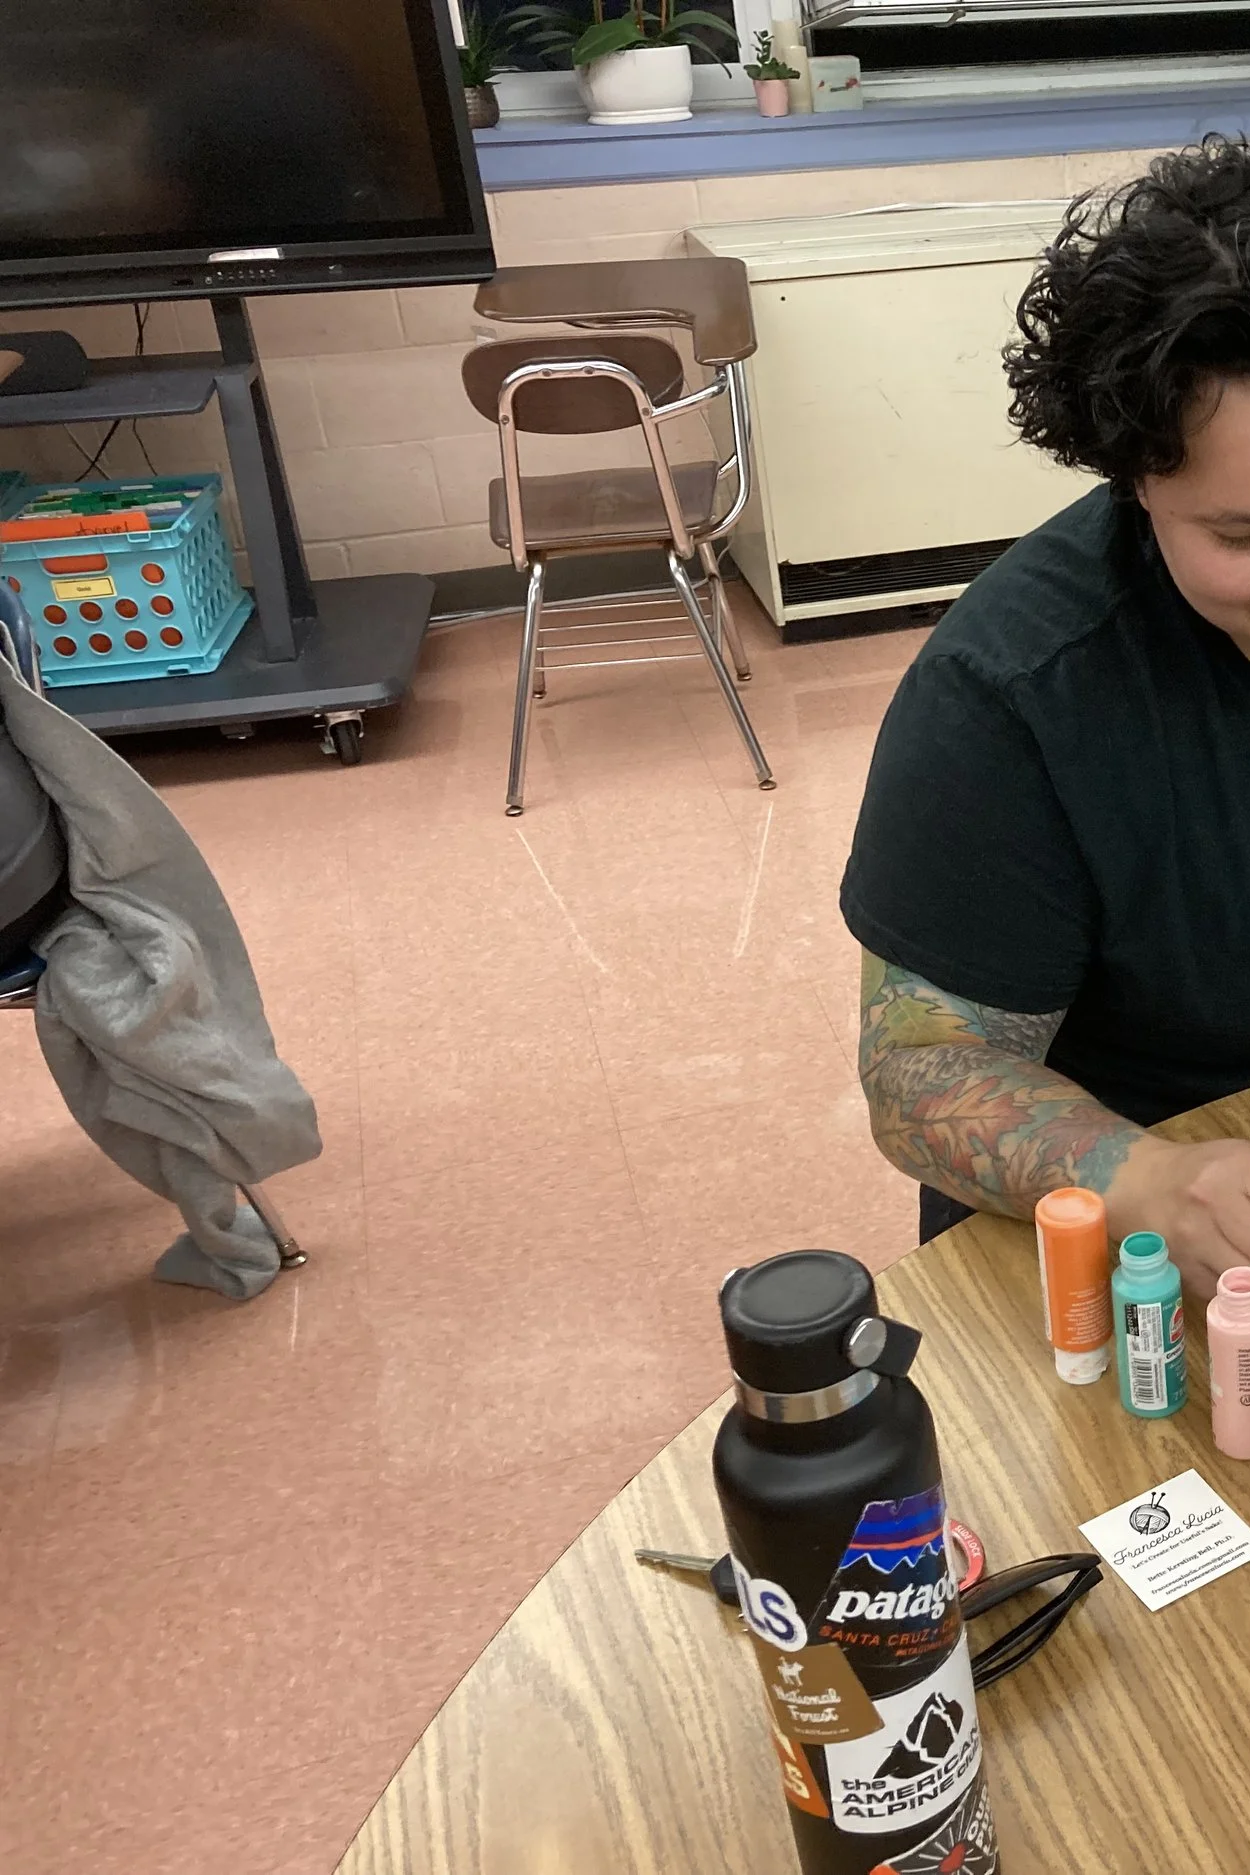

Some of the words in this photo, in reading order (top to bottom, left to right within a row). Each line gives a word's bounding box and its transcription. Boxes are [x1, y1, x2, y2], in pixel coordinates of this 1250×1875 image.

[1113, 1527, 1184, 1565] Francesca
[1183, 1504, 1224, 1530] Lucia
[1169, 1541, 1180, 1552] for
[819, 1625, 881, 1647] SANTA
[887, 1627, 930, 1647] CRUZ
[772, 1683, 842, 1706] National
[787, 1704, 840, 1722] Forest
[841, 1778, 887, 1791] the
[843, 1774, 955, 1818] ALPINE
